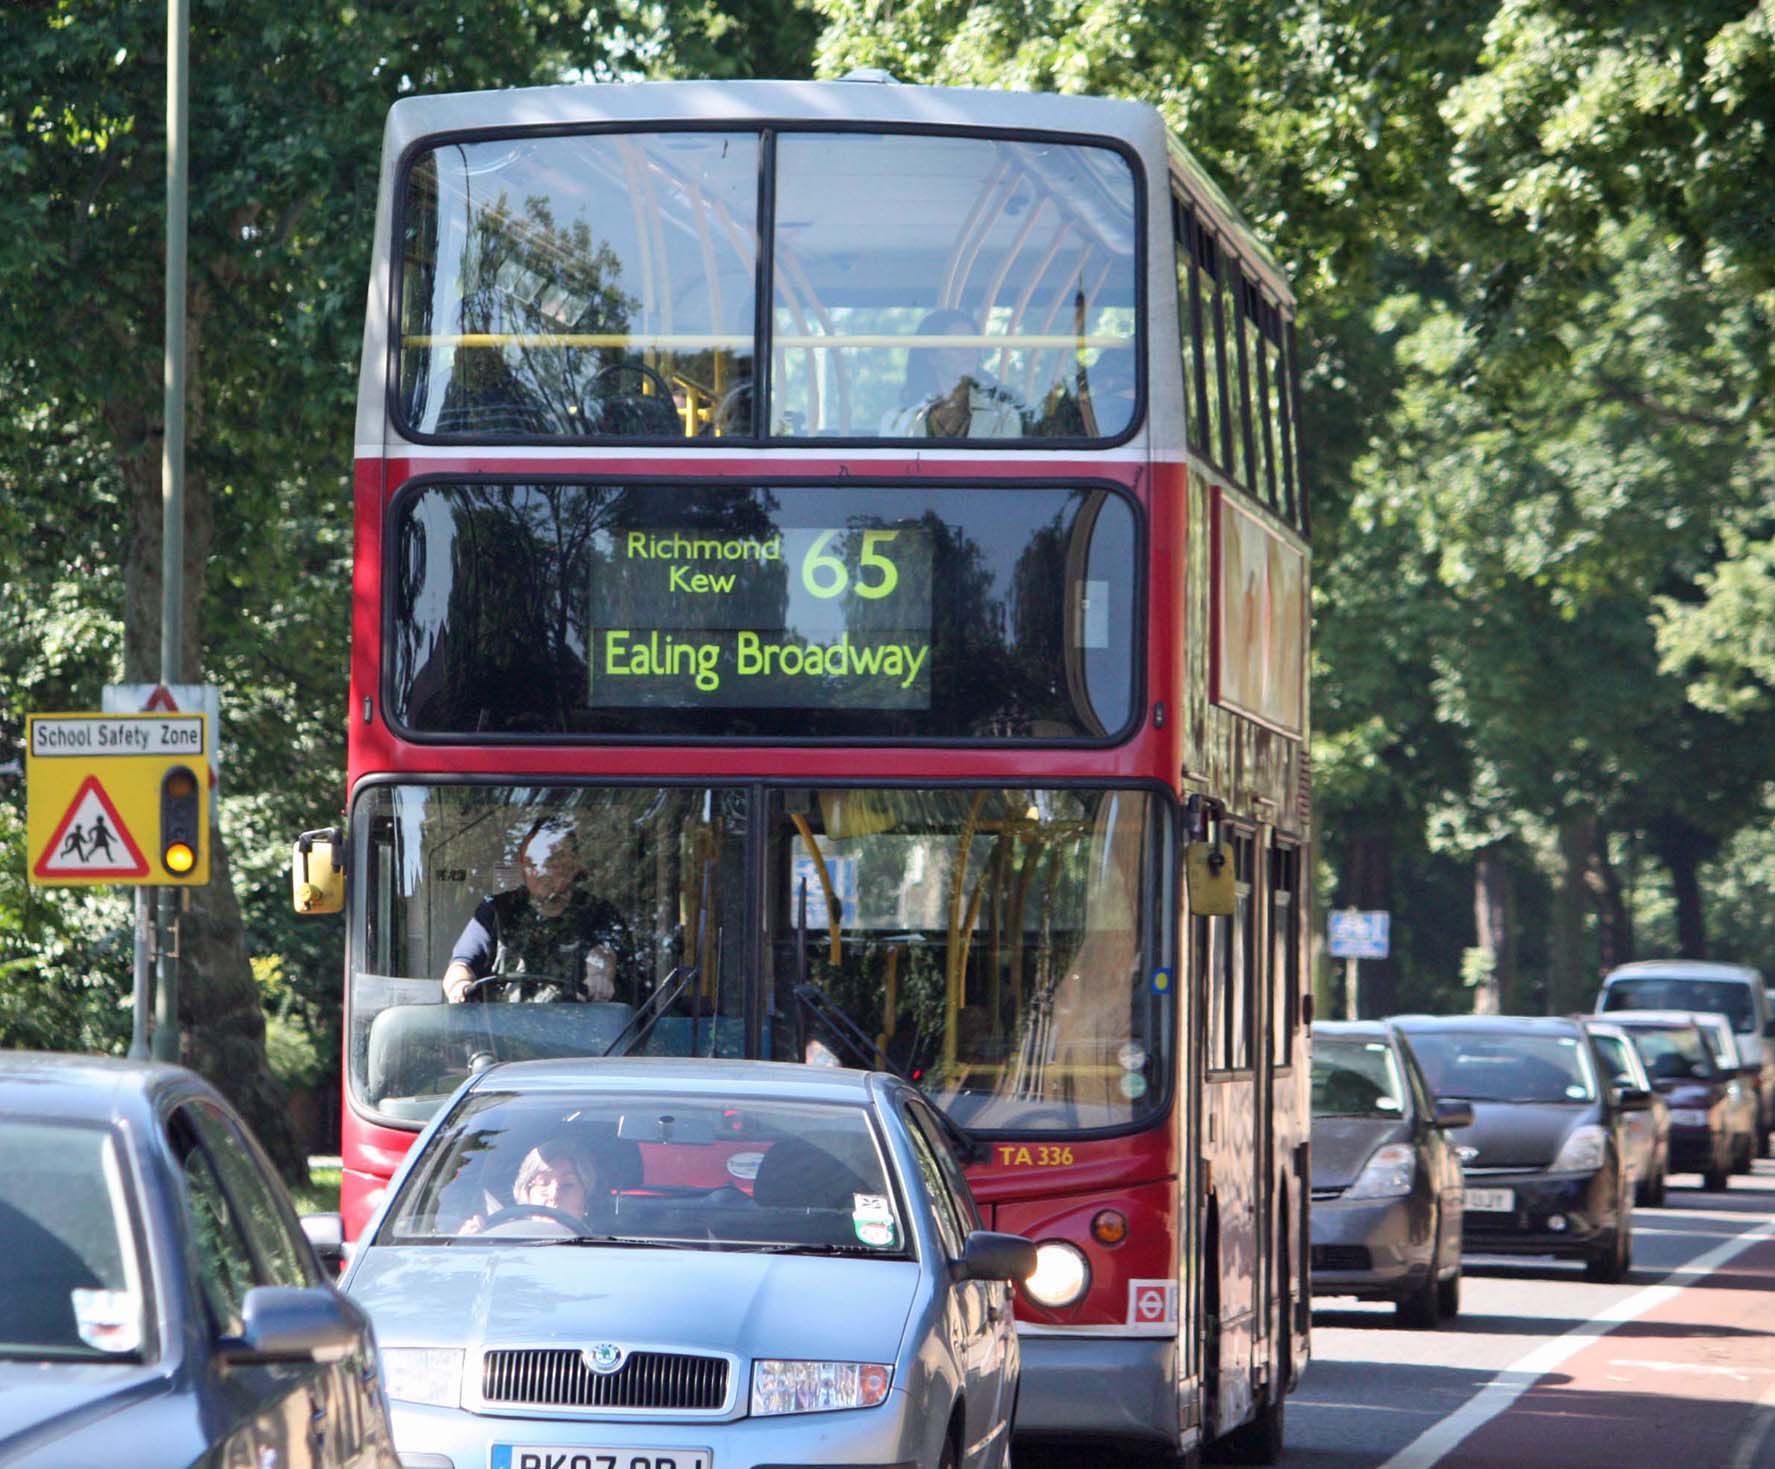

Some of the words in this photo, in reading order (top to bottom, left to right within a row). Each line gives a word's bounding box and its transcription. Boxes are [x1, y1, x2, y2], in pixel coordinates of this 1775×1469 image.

[627, 531, 781, 560] Richmond
[802, 528, 899, 599] 65
[669, 566, 736, 593] Kew
[606, 631, 720, 690] Ealing
[737, 631, 929, 688] Broadway
[37, 725, 92, 747] School
[98, 724, 150, 749] Safety
[160, 725, 198, 745] Zone
[999, 1147, 1033, 1166] TA
[1037, 1147, 1073, 1166] 336
